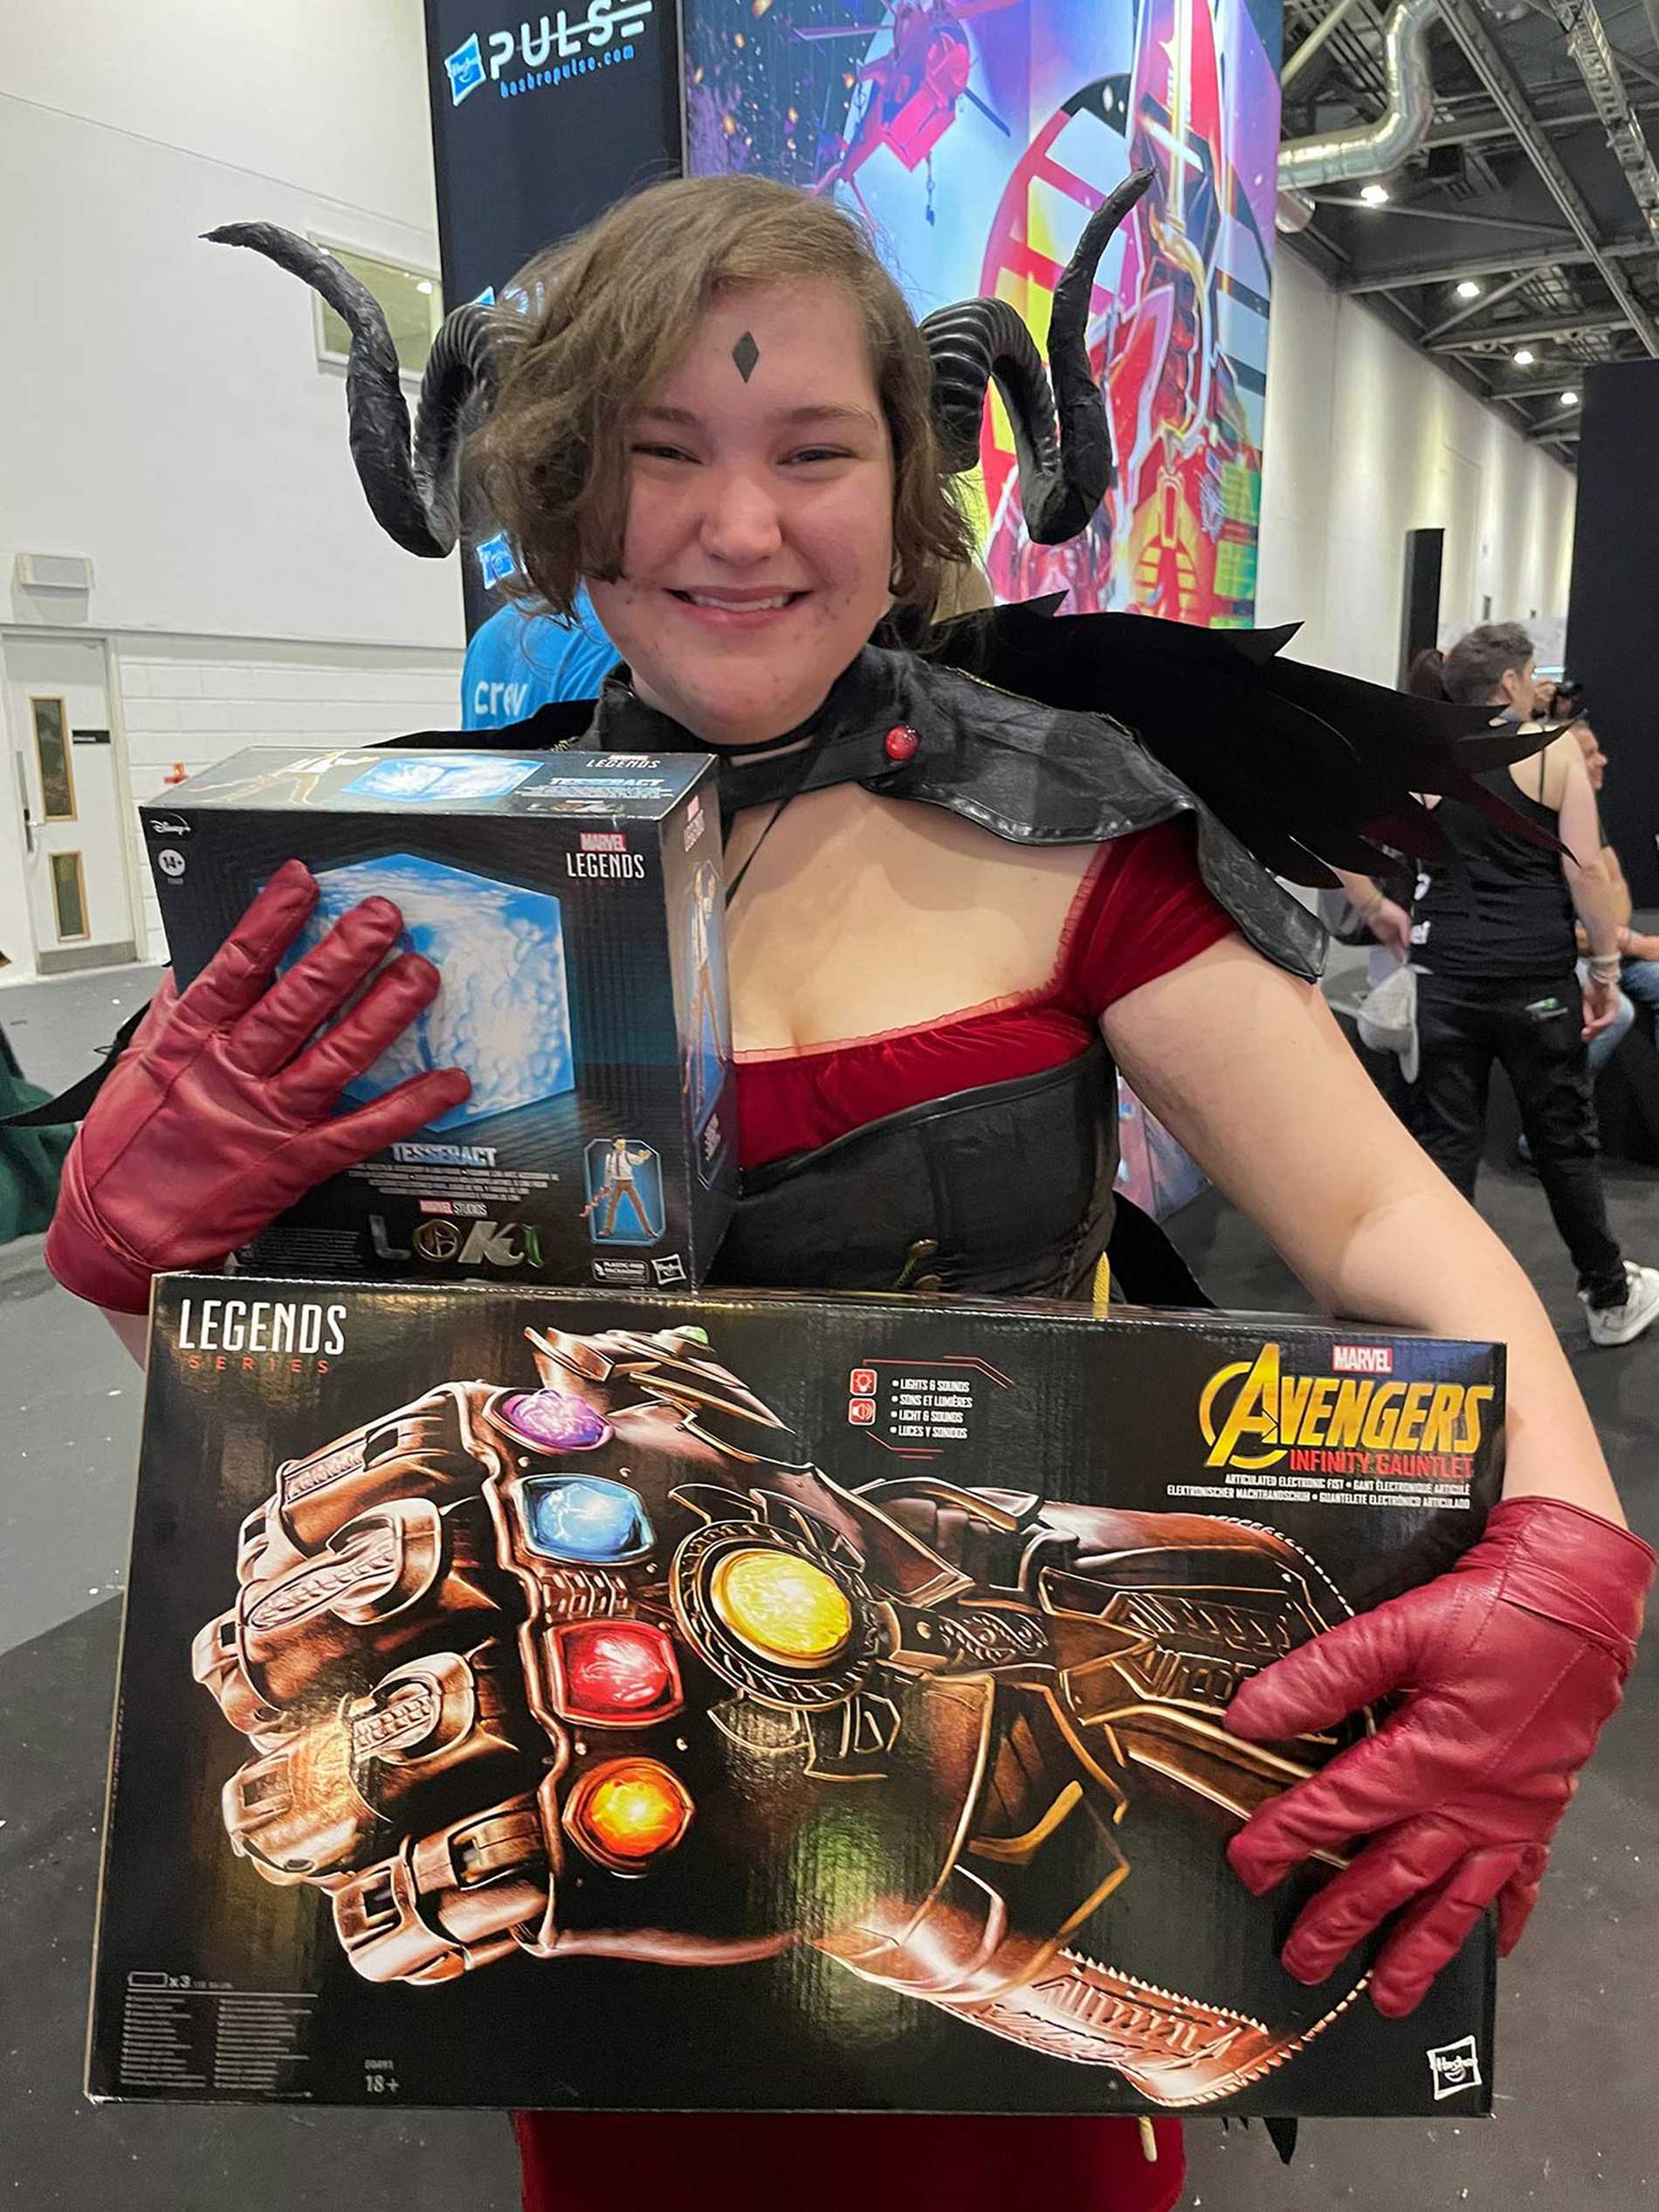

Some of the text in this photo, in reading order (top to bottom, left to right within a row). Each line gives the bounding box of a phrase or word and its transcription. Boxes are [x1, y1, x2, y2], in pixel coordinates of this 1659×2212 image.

[499, 44, 635, 99] hasbropulse.com
[587, 759, 660, 768] LEGENDS
[566, 851, 644, 879] LEGENDS
[179, 1299, 347, 1354] LEGENDS
[189, 1354, 330, 1374] SERIES
[1332, 1346, 1394, 1373] MARVEL
[900, 1378, 928, 1390] LIGHTS
[937, 1380, 970, 1393] SOUNDS
[1199, 1343, 1494, 1469] AVENGERS
[931, 1410, 964, 1423] SOUNDS
[898, 1425, 924, 1437] LUCES
[925, 1426, 932, 1438] Y
[1290, 1449, 1473, 1479] INFINITY GAUNTLET
[1225, 1473, 1277, 1486] ARTICULATED
[1278, 1476, 1325, 1489] ELECTRONIC
[1327, 1478, 1345, 1490] FIST
[366, 2075, 399, 2093] 18+
